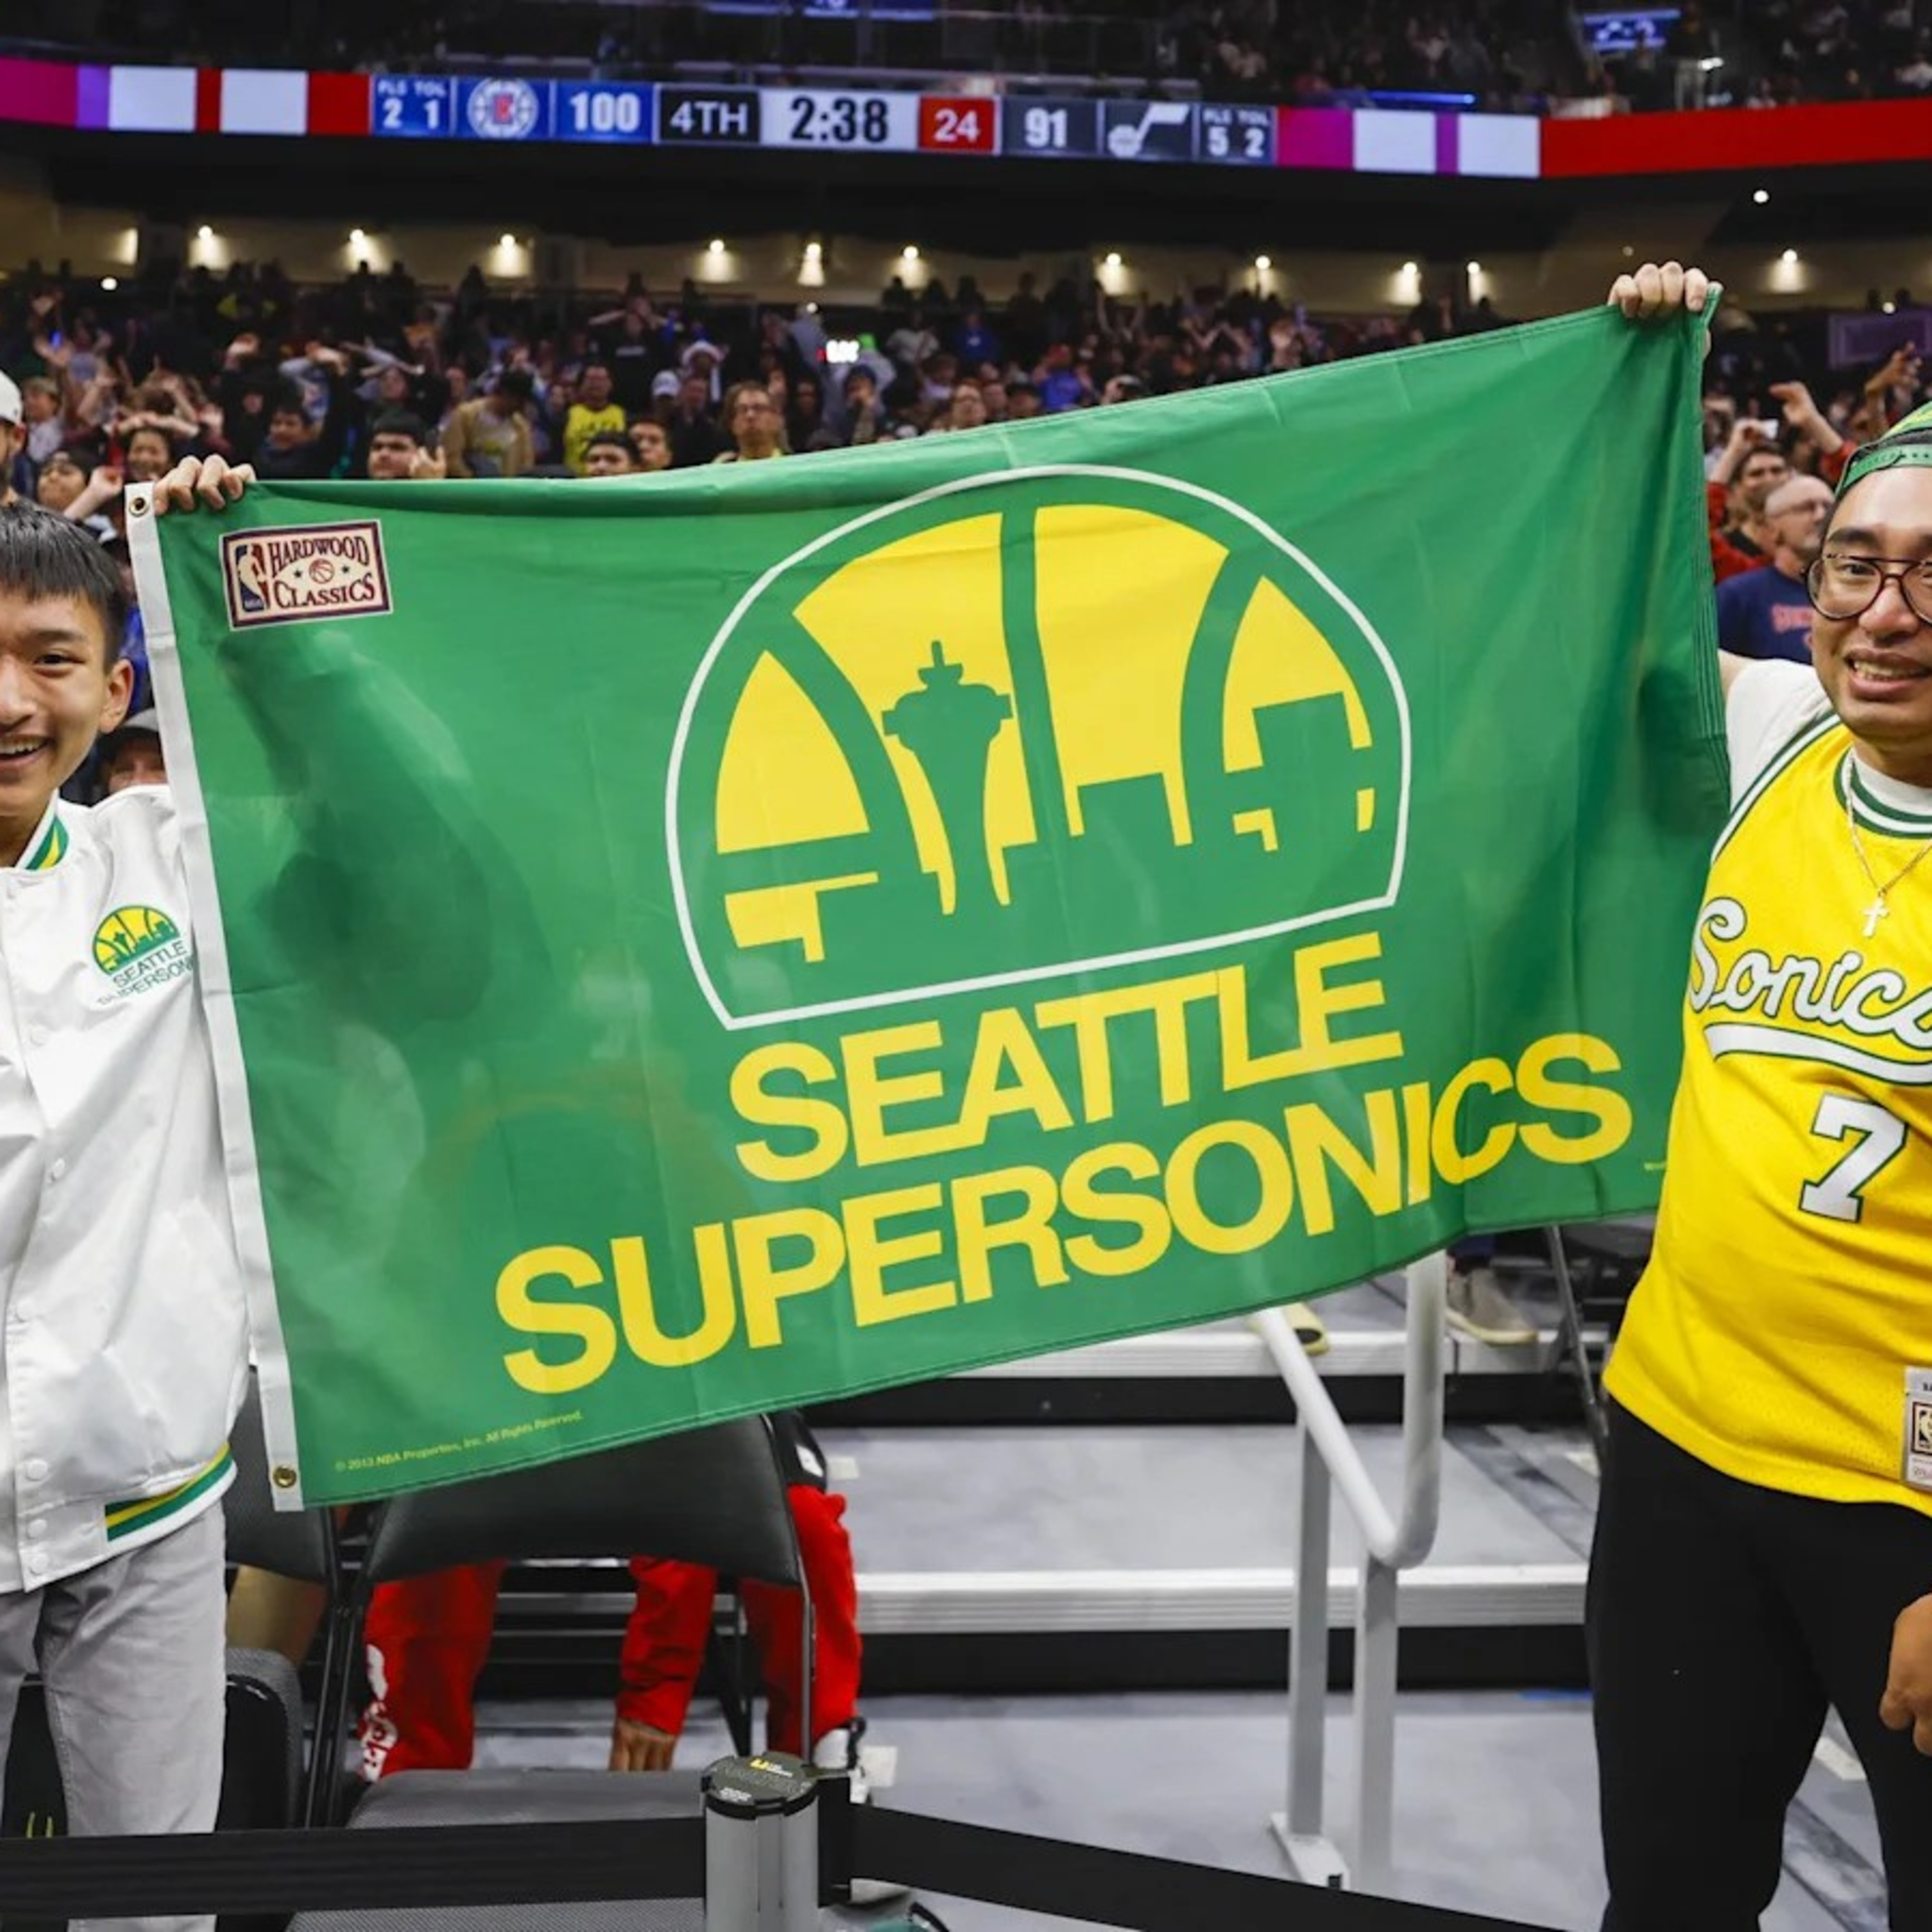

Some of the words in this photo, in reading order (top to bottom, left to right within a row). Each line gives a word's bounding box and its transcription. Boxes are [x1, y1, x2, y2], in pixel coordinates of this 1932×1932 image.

[384, 98, 402, 128] 2
[425, 99, 439, 128] 1
[570, 92, 640, 133] 100
[670, 101, 748, 134] 4TH
[790, 95, 888, 143] 2:38
[934, 108, 980, 142] 24
[1025, 108, 1067, 148] 91
[1209, 126, 1227, 155] 5
[1245, 128, 1264, 157] 2
[267, 536, 370, 578] HARDWOOD
[273, 572, 375, 609] CLASSICS
[113, 940, 187, 988] SEATTLE
[729, 932, 1403, 1182] SEATTLE
[1798, 1092, 1908, 1224] 7
[495, 1032, 1633, 1394] SUPERSONICS
[375, 1452, 401, 1466] NBA
[485, 1430, 498, 1443] All
[500, 1424, 533, 1439] Rights
